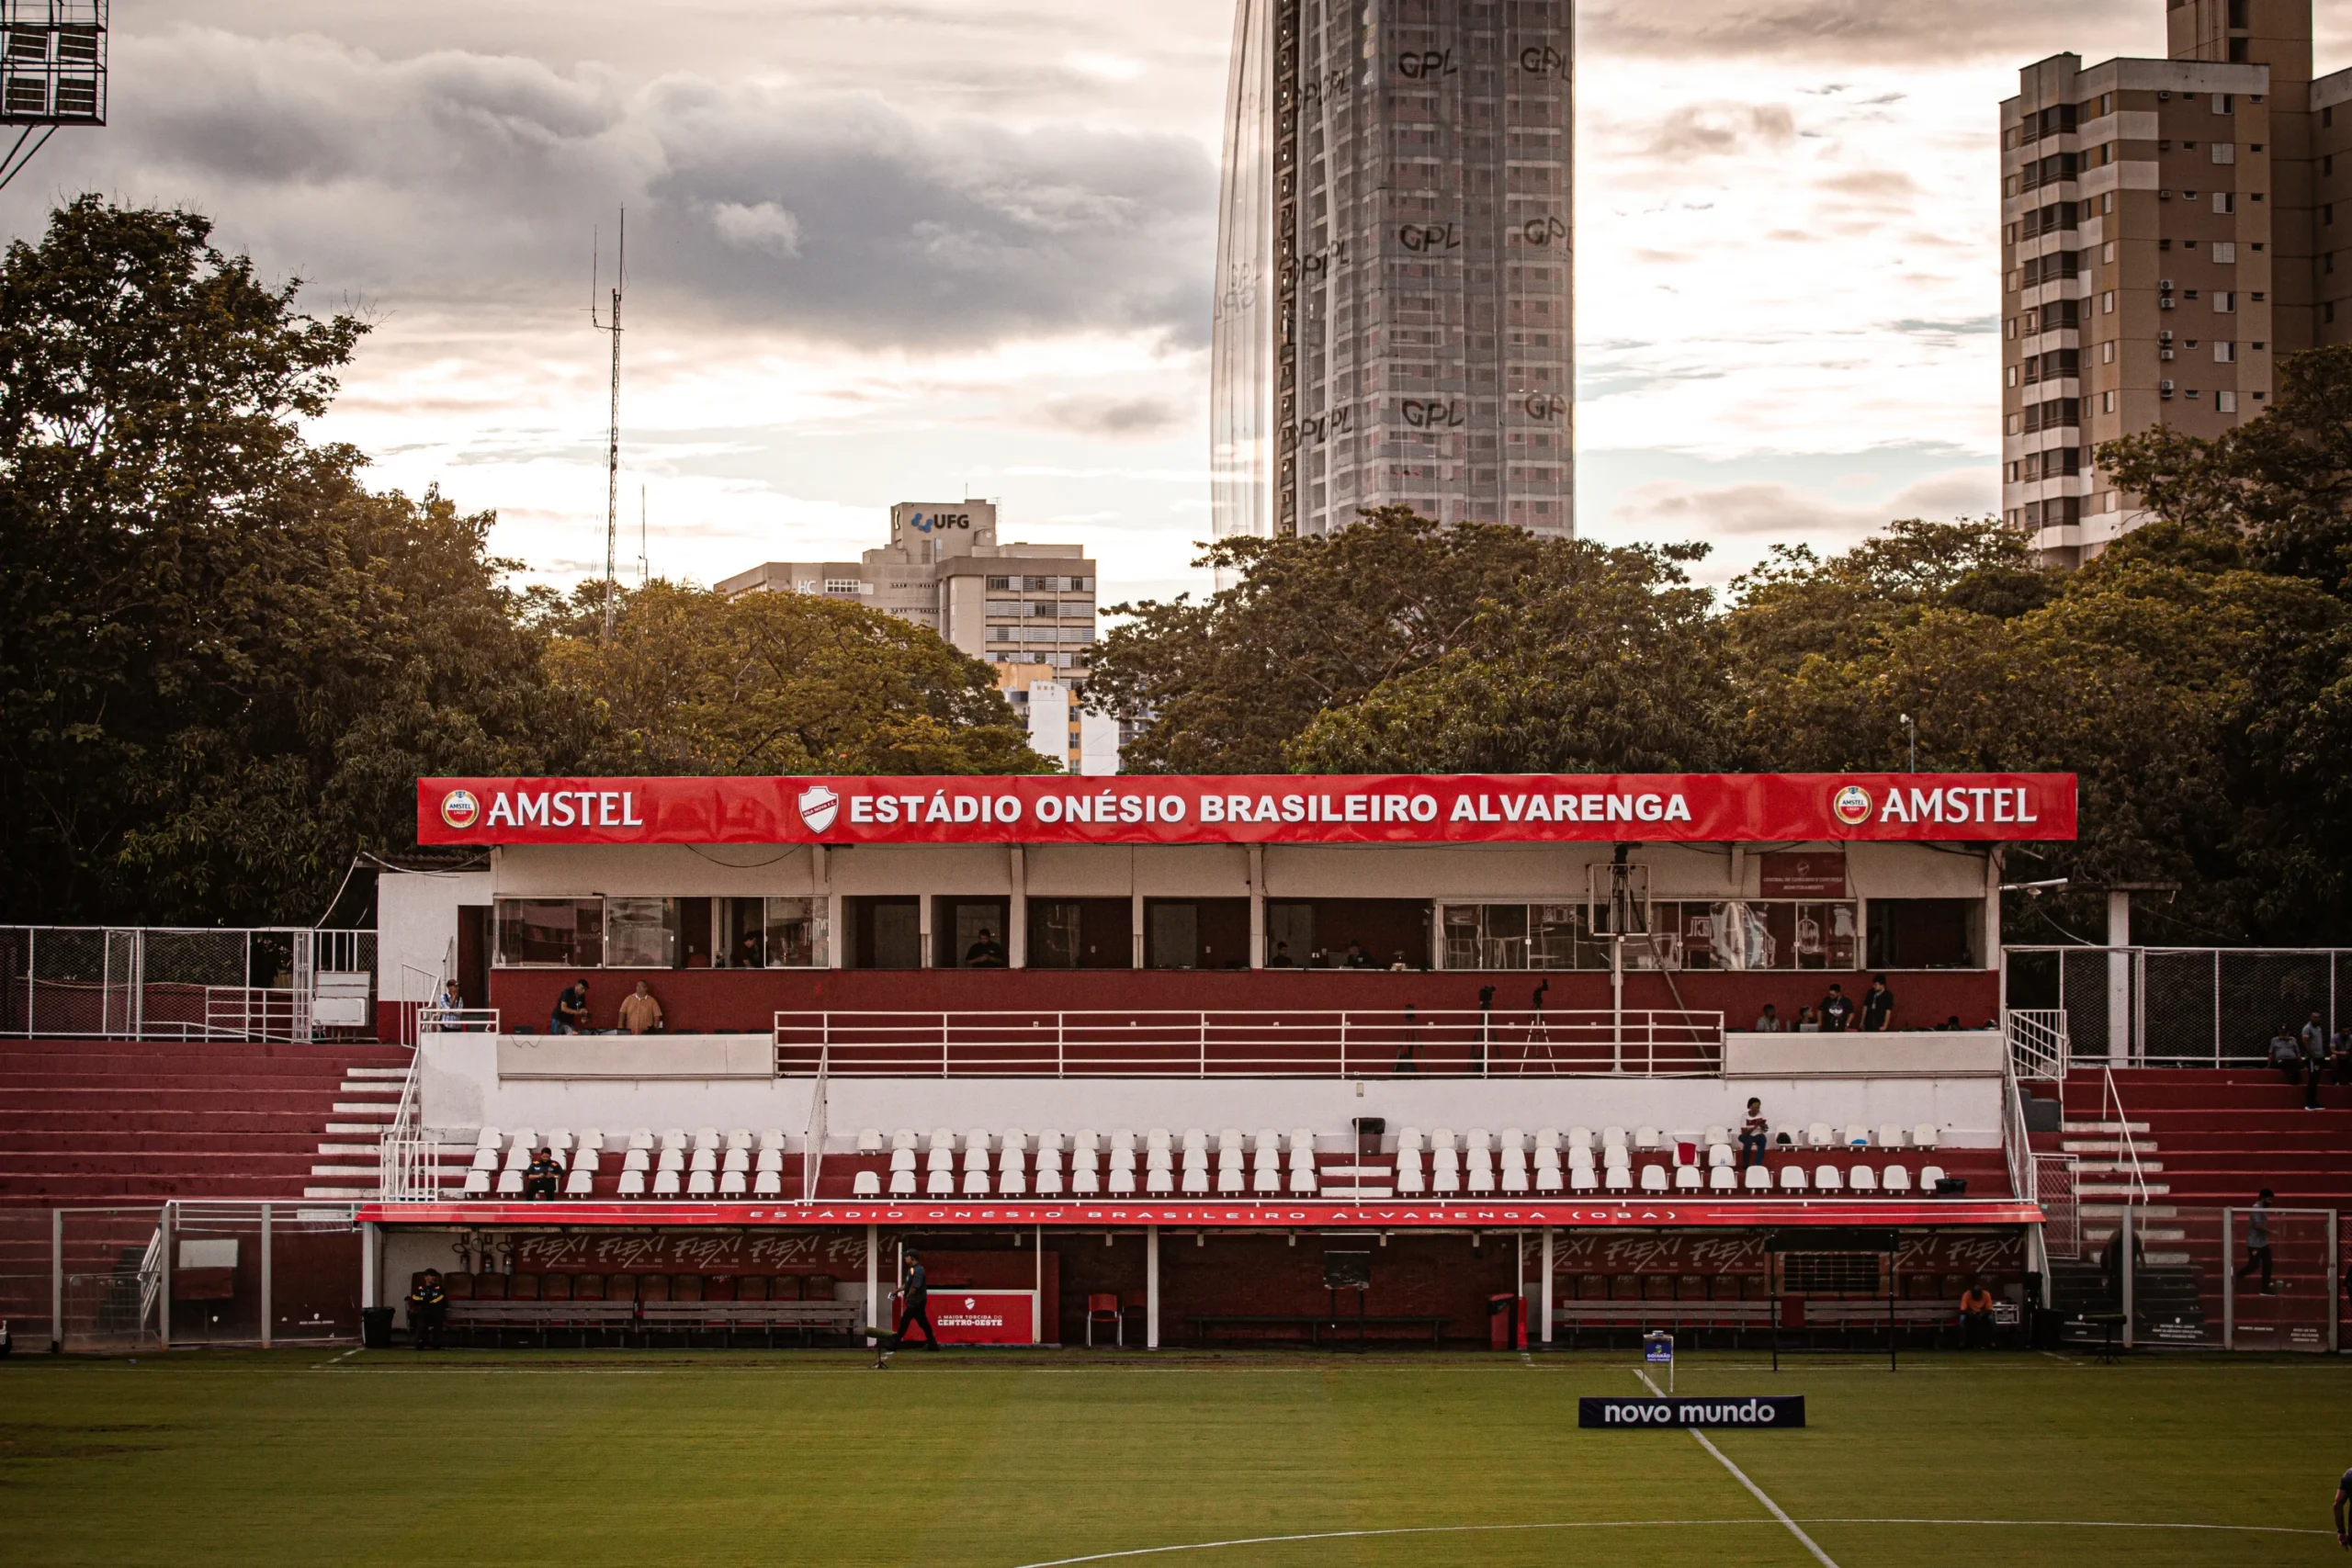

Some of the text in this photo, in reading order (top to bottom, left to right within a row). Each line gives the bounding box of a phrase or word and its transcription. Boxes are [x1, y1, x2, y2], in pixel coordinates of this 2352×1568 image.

[1398, 49, 1458, 79] GPL
[1400, 222, 1461, 252] GPL
[1402, 400, 1464, 429] GPL
[933, 513, 969, 529] UFG
[797, 580, 817, 594] HC
[486, 791, 643, 826] AMSTEL
[804, 808, 814, 818] VILA
[814, 804, 828, 812] NOVA
[851, 788, 1691, 823] ESTÁDIO ONÉSIO BRASILEIRO ALVARENGA
[1880, 787, 2038, 823] AMSTEL
[750, 1210, 903, 1218] ESTÁDIO
[929, 1210, 1062, 1218] ONÉSIO
[1572, 1211, 1676, 1220] (OBA)
[518, 1235, 590, 1269] FLEXI
[595, 1235, 667, 1269] FLEXI
[673, 1235, 743, 1269] FLEXI
[750, 1235, 821, 1269] FLEXI
[1603, 1237, 1683, 1273] FLEXI
[1689, 1237, 1769, 1273] FLEXI
[1946, 1236, 2024, 1273] FLEXI
[1605, 1398, 1775, 1422] novo mundo
